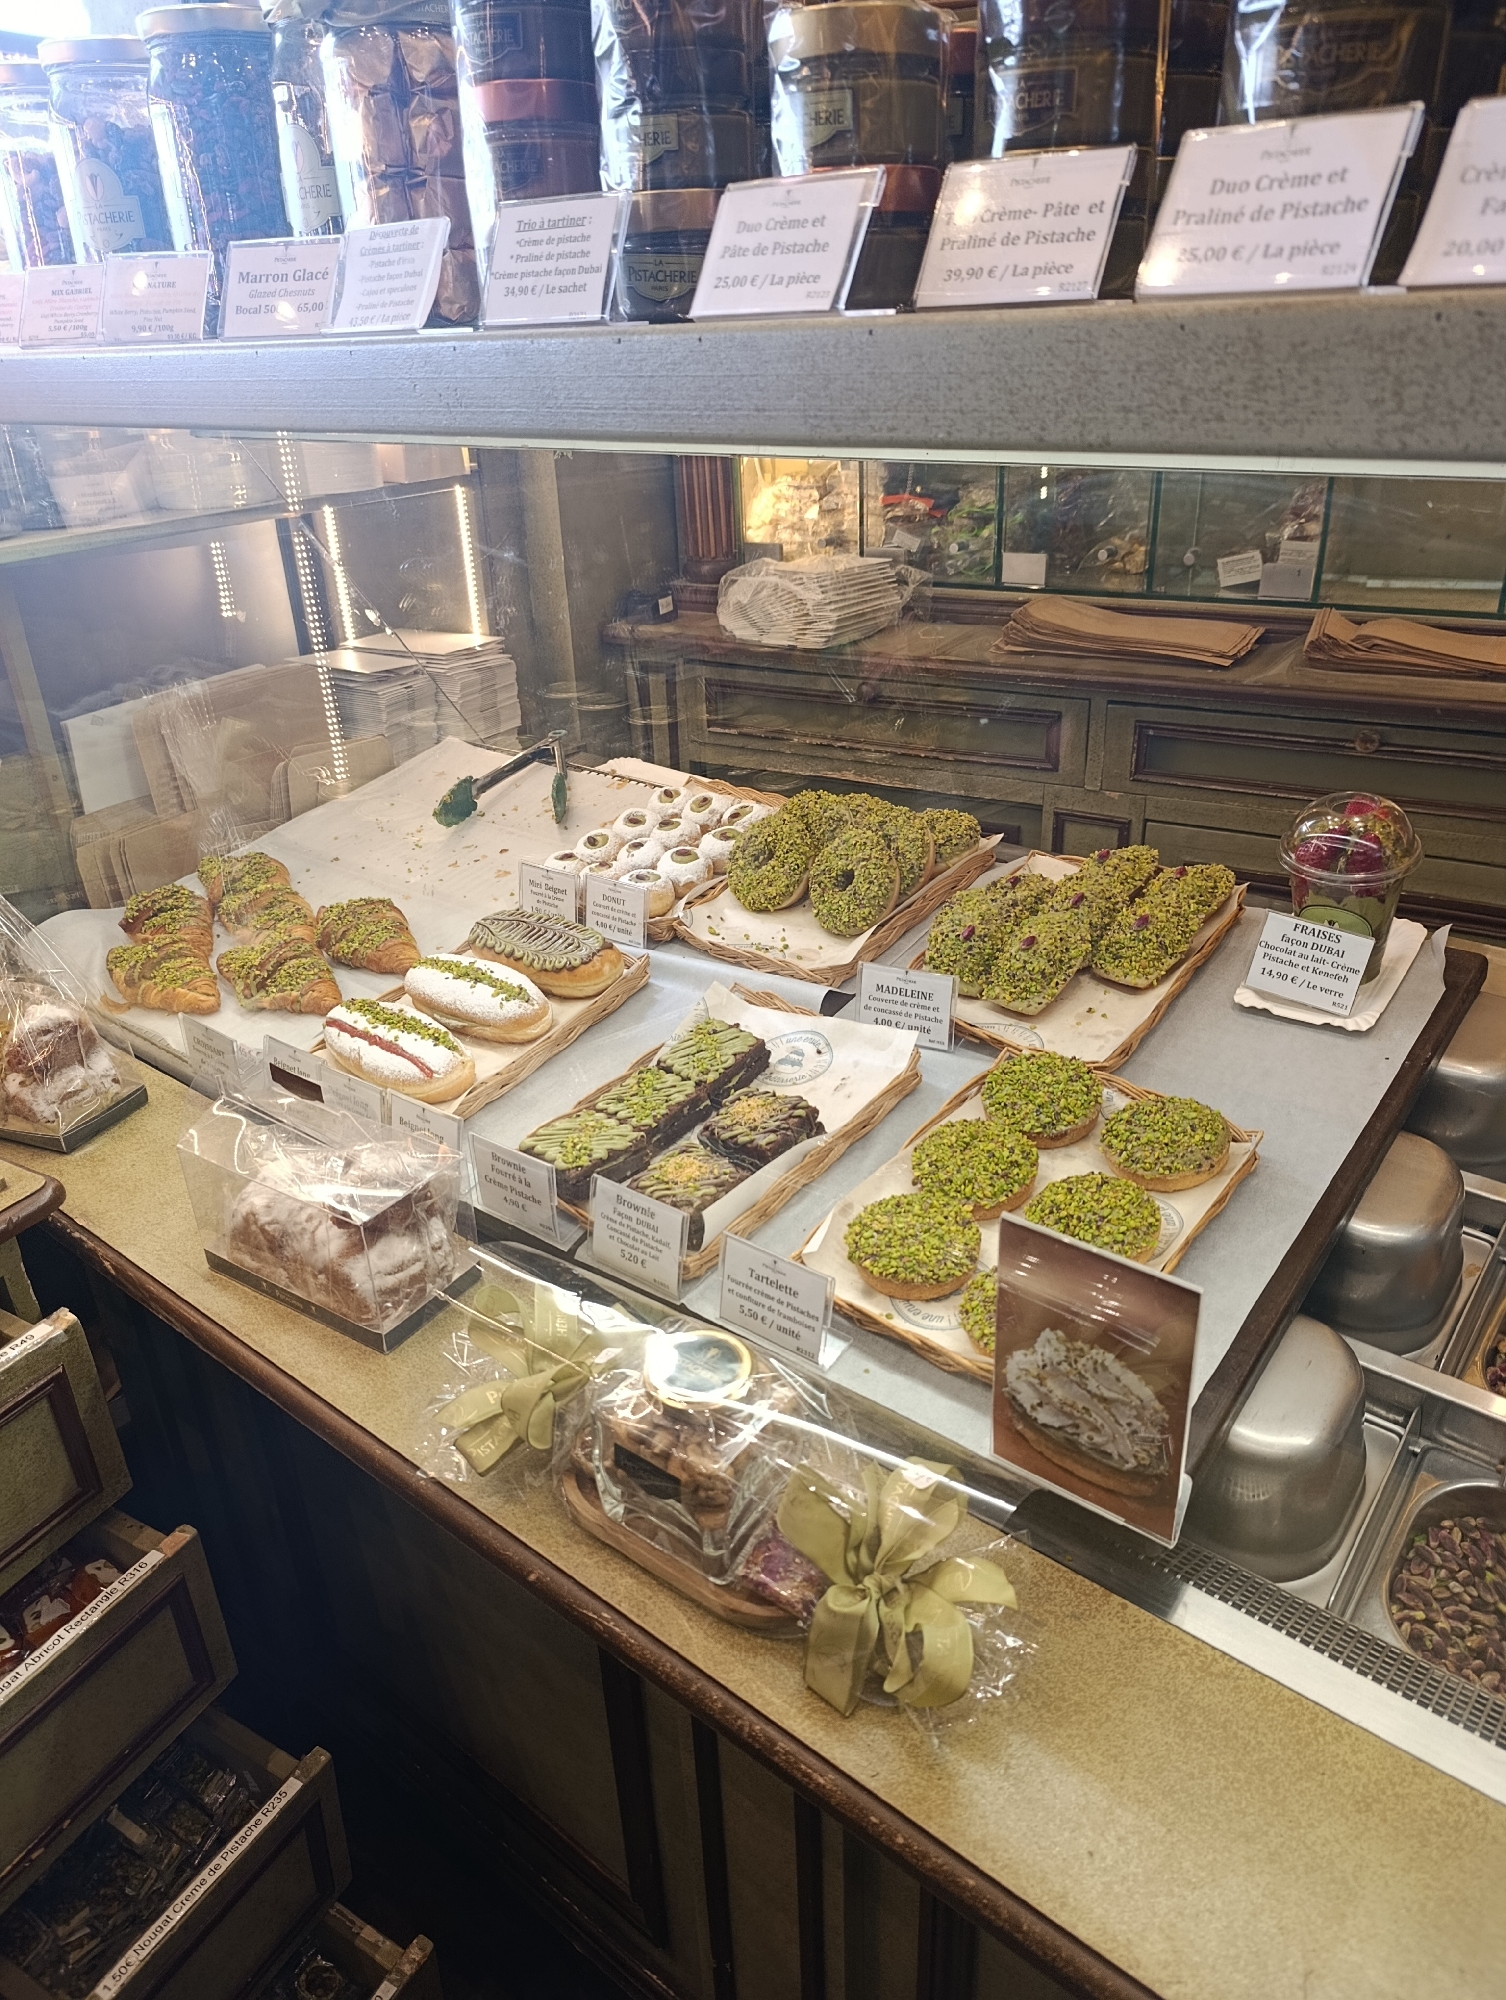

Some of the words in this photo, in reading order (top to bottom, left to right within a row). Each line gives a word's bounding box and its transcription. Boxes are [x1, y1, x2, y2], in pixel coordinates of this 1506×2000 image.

[1209, 177, 1250, 196] Duo
[1255, 169, 1322, 191] Crème
[1327, 166, 1350, 184] et
[1043, 202, 1080, 218] Pâte
[1088, 200, 1105, 214] et
[1173, 206, 1245, 226] Praliné
[1249, 204, 1274, 222] de
[1279, 198, 1370, 220] Pistache
[409, 225, 419, 234] de
[517, 220, 536, 232] Trio
[539, 217, 545, 229] à
[547, 215, 587, 228] tartiner
[736, 220, 762, 234] Duo
[765, 216, 809, 232] Crème
[812, 215, 827, 227] et
[360, 246, 385, 256] Crèmes
[387, 244, 391, 253] à
[392, 241, 420, 252] tartiner
[545, 236, 555, 245] de
[556, 233, 591, 246] pistache
[940, 233, 996, 251] Praliné
[1000, 231, 1020, 246] de
[1024, 227, 1096, 245] Pistache
[515, 251, 543, 263] Praliné
[545, 251, 555, 261] de
[556, 249, 590, 262] pistache
[720, 244, 750, 259] Pâte
[753, 242, 769, 257] de
[771, 239, 830, 255] Pistache
[1230, 245, 1245, 261] €
[1262, 242, 1284, 258] La
[1287, 240, 1341, 262] pièce
[520, 268, 552, 280] pistache
[554, 265, 576, 278] façon
[578, 263, 602, 274] Dubai
[654, 259, 664, 267] LA
[943, 267, 984, 283] 39,90
[987, 265, 998, 279] €
[999, 265, 1010, 281] /
[1011, 263, 1029, 277] La
[1032, 262, 1074, 279] pièce
[238, 271, 288, 284] Marron
[293, 267, 329, 281] Glacé
[628, 266, 698, 284] PISTACHERIE
[714, 276, 748, 289] 25,00
[750, 275, 760, 286] €
[759, 274, 769, 289] /
[770, 274, 784, 286] La
[786, 272, 821, 288] pièce
[249, 289, 277, 299] Glazed
[278, 287, 316, 298] Chesnuts
[504, 285, 528, 297] 34,90
[531, 285, 538, 295] €
[538, 284, 544, 297] /
[546, 284, 556, 294] Le
[558, 282, 587, 293] sachet
[235, 304, 262, 315] Bocal
[297, 302, 324, 313] 65,00
[545, 883, 567, 895] Beignet
[602, 893, 626, 906] DONUT
[617, 928, 632, 936] unité
[1293, 923, 1342, 944] FRAISES
[1280, 934, 1308, 949] façon
[1311, 942, 1345, 958] DUBAI
[1259, 940, 1296, 956] Chocolat
[1298, 951, 1309, 960] au
[1311, 954, 1330, 966] lait-
[1331, 961, 1360, 975] Crème
[1262, 952, 1299, 969] Pistache
[1301, 964, 1310, 973] et
[1312, 967, 1349, 983] Kenefeh
[1260, 967, 1288, 981] 14,90
[1291, 976, 1298, 984] €
[1299, 979, 1305, 988] /
[1307, 981, 1317, 990] Le
[1319, 987, 1344, 998] verre
[875, 984, 934, 1001] MADELEINE
[868, 994, 898, 1005] Couverte
[910, 1002, 931, 1011] crème
[1332, 1001, 1348, 1010] R521
[874, 1007, 902, 1016] concassé
[914, 1012, 943, 1024] Pistache
[907, 1024, 931, 1034] unité
[491, 1151, 526, 1174] Brownie
[491, 1164, 516, 1181] Fourré
[518, 1176, 523, 1184] à
[524, 1180, 531, 1188] la
[485, 1175, 508, 1191] Crème
[510, 1185, 541, 1206] Pistache
[503, 1196, 519, 1209] 4,90
[521, 1203, 527, 1212] €
[616, 1194, 655, 1219] Brownie
[600, 1212, 617, 1225] Crème
[613, 1207, 633, 1222] Façon
[636, 1217, 659, 1233] DUBAI
[606, 1223, 631, 1239] Concassé
[632, 1235, 639, 1243] de
[640, 1238, 663, 1253] Pistache
[616, 1237, 640, 1252] Chocolat
[648, 1251, 660, 1262] Lait
[620, 1249, 639, 1264] 5,20
[641, 1259, 647, 1268] €
[748, 1267, 799, 1299] Tartelette
[728, 1287, 734, 1295] et
[735, 1291, 765, 1308] confiture
[767, 1305, 776, 1314] de
[776, 1307, 816, 1332] framboises
[753, 1288, 775, 1301] crème
[776, 1297, 784, 1306] de
[786, 1301, 819, 1322] Pistaches
[739, 1304, 758, 1320] 5,50
[761, 1316, 767, 1325] €
[769, 1319, 775, 1329] /
[776, 1323, 801, 1340] unité
[25, 1634, 65, 1671] Abricot
[64, 1587, 118, 1634] Rectangle
[118, 1561, 148, 1587] R316
[133, 1914, 173, 1956] Nougat
[173, 1877, 208, 1914] Creme
[207, 1863, 222, 1878] de
[220, 1818, 262, 1861] Pistache
[261, 1789, 288, 1818] R235
